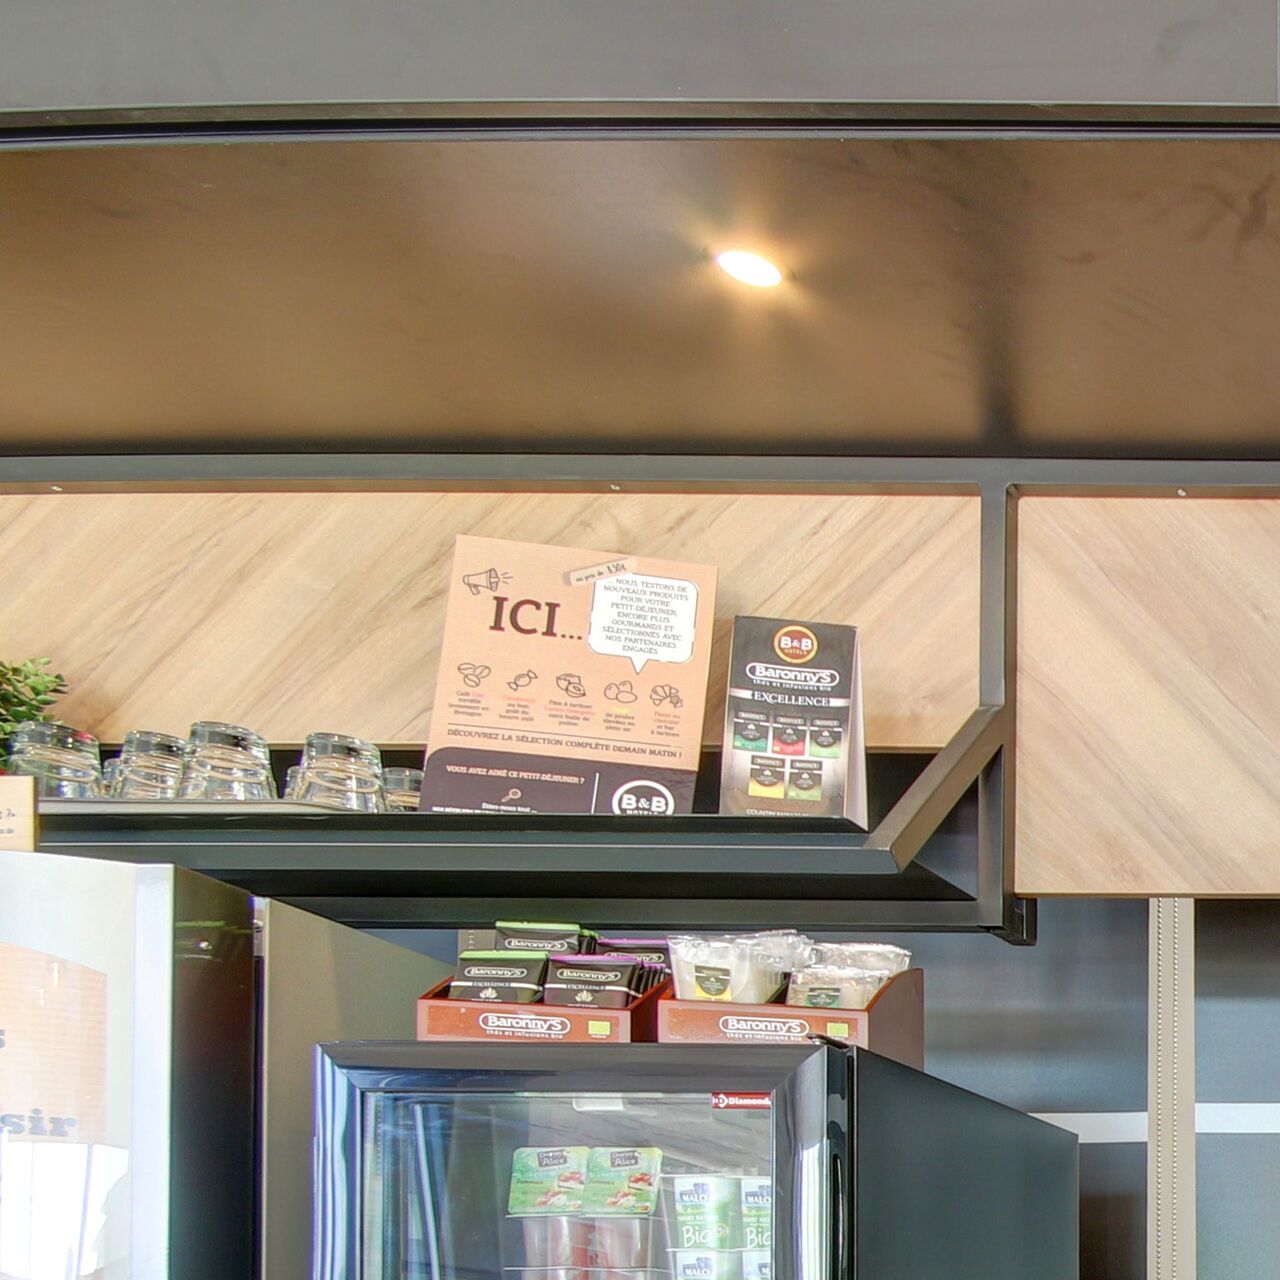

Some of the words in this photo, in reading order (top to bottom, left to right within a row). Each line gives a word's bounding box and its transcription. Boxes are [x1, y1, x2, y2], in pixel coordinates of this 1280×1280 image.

[616, 578, 638, 587] NOUS
[604, 585, 647, 596] NOUVEAUX
[649, 590, 689, 601] PRODUITS
[620, 595, 643, 604] POUR
[644, 598, 670, 608] VOTRE
[780, 636, 812, 650] B&B
[754, 691, 829, 707] EXCELLENCE
[447, 728, 499, 741] DÉCOUVREZ
[501, 733, 513, 742] LA
[515, 734, 563, 747] SÉLECTION
[612, 745, 647, 755] DEMAIN
[648, 749, 677, 758] MATIN
[446, 765, 467, 773] VOUS
[468, 767, 487, 775] AVEZ
[621, 794, 666, 812] B&B
[514, 1030, 549, 1038] infusions
[754, 1033, 789, 1041] infusions
[682, 1194, 708, 1202] MALO
[684, 1268, 709, 1276] MALO
